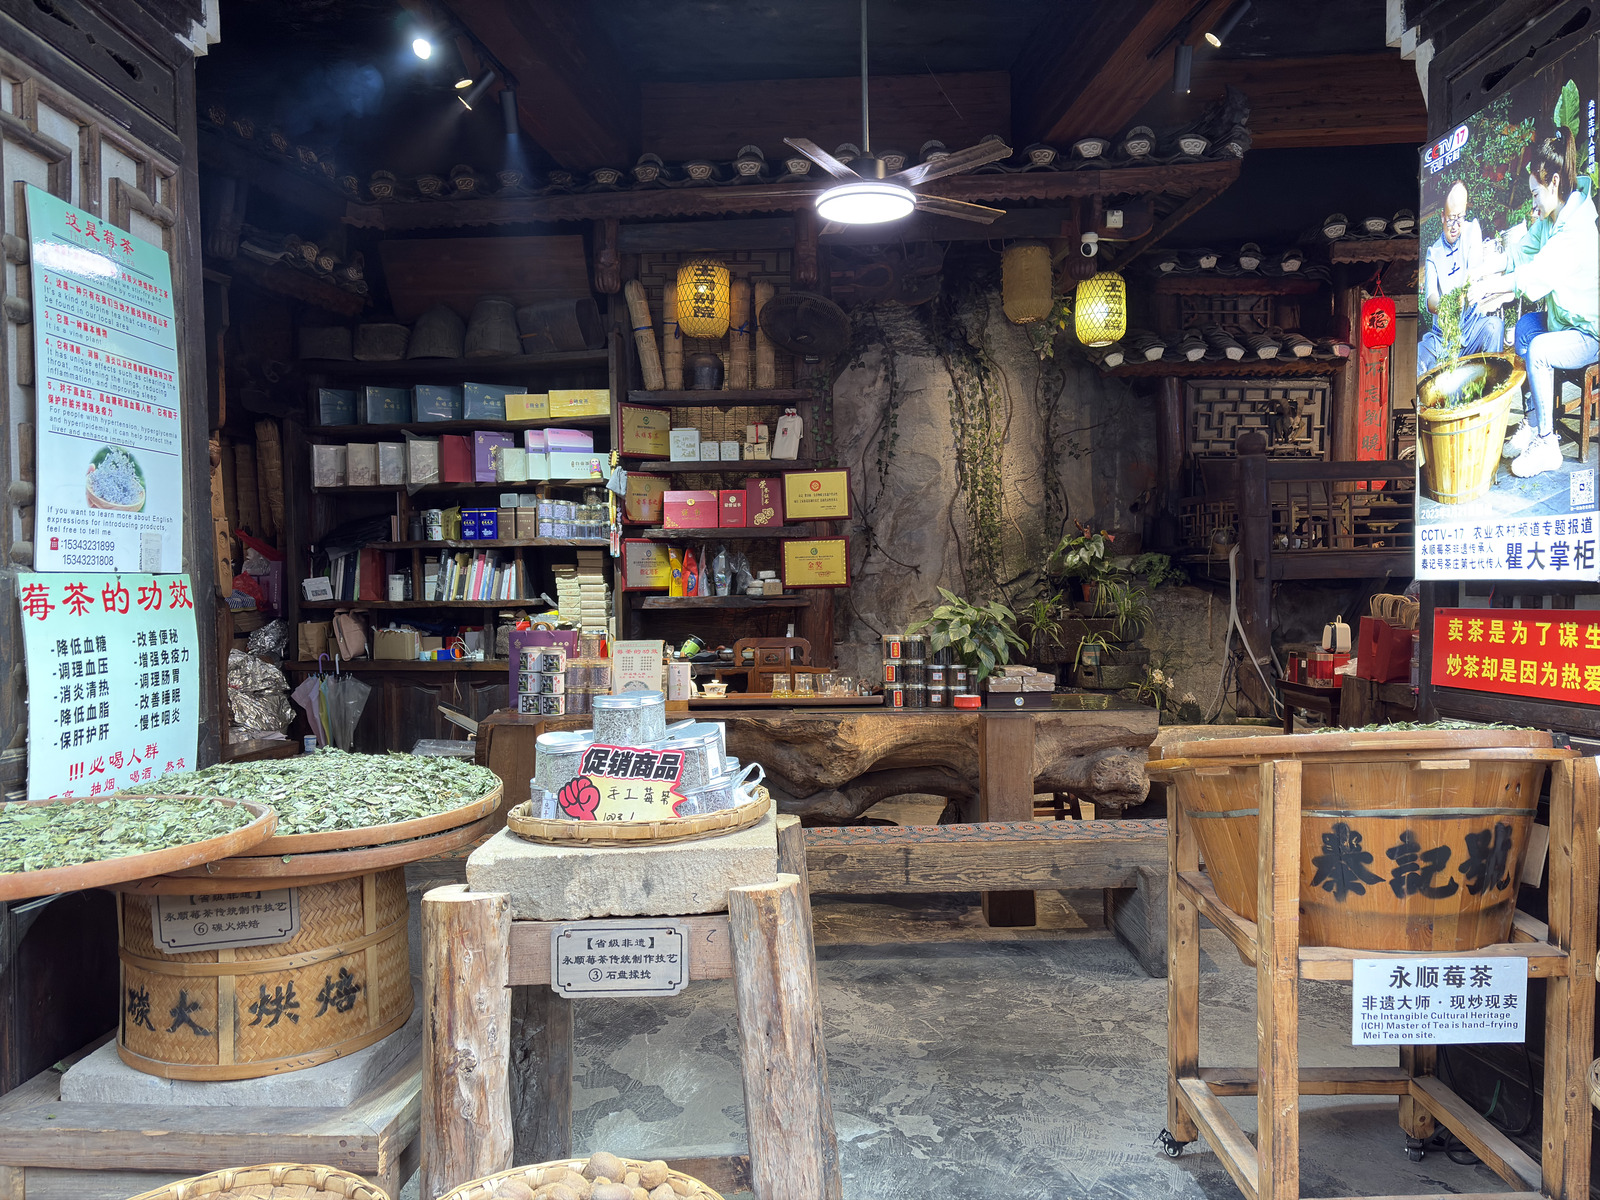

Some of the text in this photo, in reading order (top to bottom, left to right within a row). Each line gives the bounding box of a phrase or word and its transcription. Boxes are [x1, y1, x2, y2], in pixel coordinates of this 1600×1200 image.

[1425, 128, 1466, 163] CCTV 17
[65, 209, 134, 257] 这是莓茶
[43, 285, 54, 296] It's
[64, 293, 78, 304] kind
[80, 299, 87, 308] of
[89, 302, 108, 316] alpine
[111, 310, 121, 320] tea
[123, 314, 134, 325] that
[136, 320, 145, 329] can
[148, 324, 159, 335] only
[44, 294, 129, 331] be found in our local area
[1368, 309, 1389, 329] 福
[45, 321, 51, 329] It
[53, 323, 59, 331] is
[69, 328, 82, 339] vine
[85, 334, 102, 346] plant
[46, 346, 51, 355] It
[54, 349, 66, 359] has
[69, 353, 92, 368] unique
[94, 361, 115, 373] effects
[118, 368, 132, 378] such
[143, 375, 165, 389] clearing
[167, 382, 175, 390] the
[47, 365, 157, 402] inflammation, and improving sleep
[46, 505, 172, 523] If you want to learn more about English
[47, 515, 88, 526] expressions
[102, 520, 137, 529] introducing
[46, 524, 60, 533] feel
[62, 525, 77, 534] free
[88, 527, 99, 535] tell
[1421, 516, 1593, 542] CCTV-17 农业农村频道专题报道
[62, 553, 113, 566] 15343231808
[1505, 539, 1596, 572] 瞿大掌柜
[21, 578, 193, 621] 莓茶的功效
[1448, 617, 1600, 650] 卖茶是为了谋生
[1446, 653, 1600, 692] 炒茶却是因为热爱
[583, 747, 682, 781] 促销商品
[211, 920, 260, 933] 碳火烘焙
[586, 936, 655, 950] 【省级非遗】
[562, 953, 678, 966] 永顺莓茶传统制作技艺
[605, 969, 652, 980] 石盘揉捻
[1388, 964, 1494, 989] 永顺莓茶
[1361, 1011, 1511, 1021] The Intangible Cultural Heritage
[1361, 1022, 1384, 1031] (ICH)
[1386, 1022, 1419, 1030] Master
[1421, 1022, 1431, 1030] of
[1432, 1022, 1450, 1030] Tea
[1363, 1032, 1381, 1040] Mei
